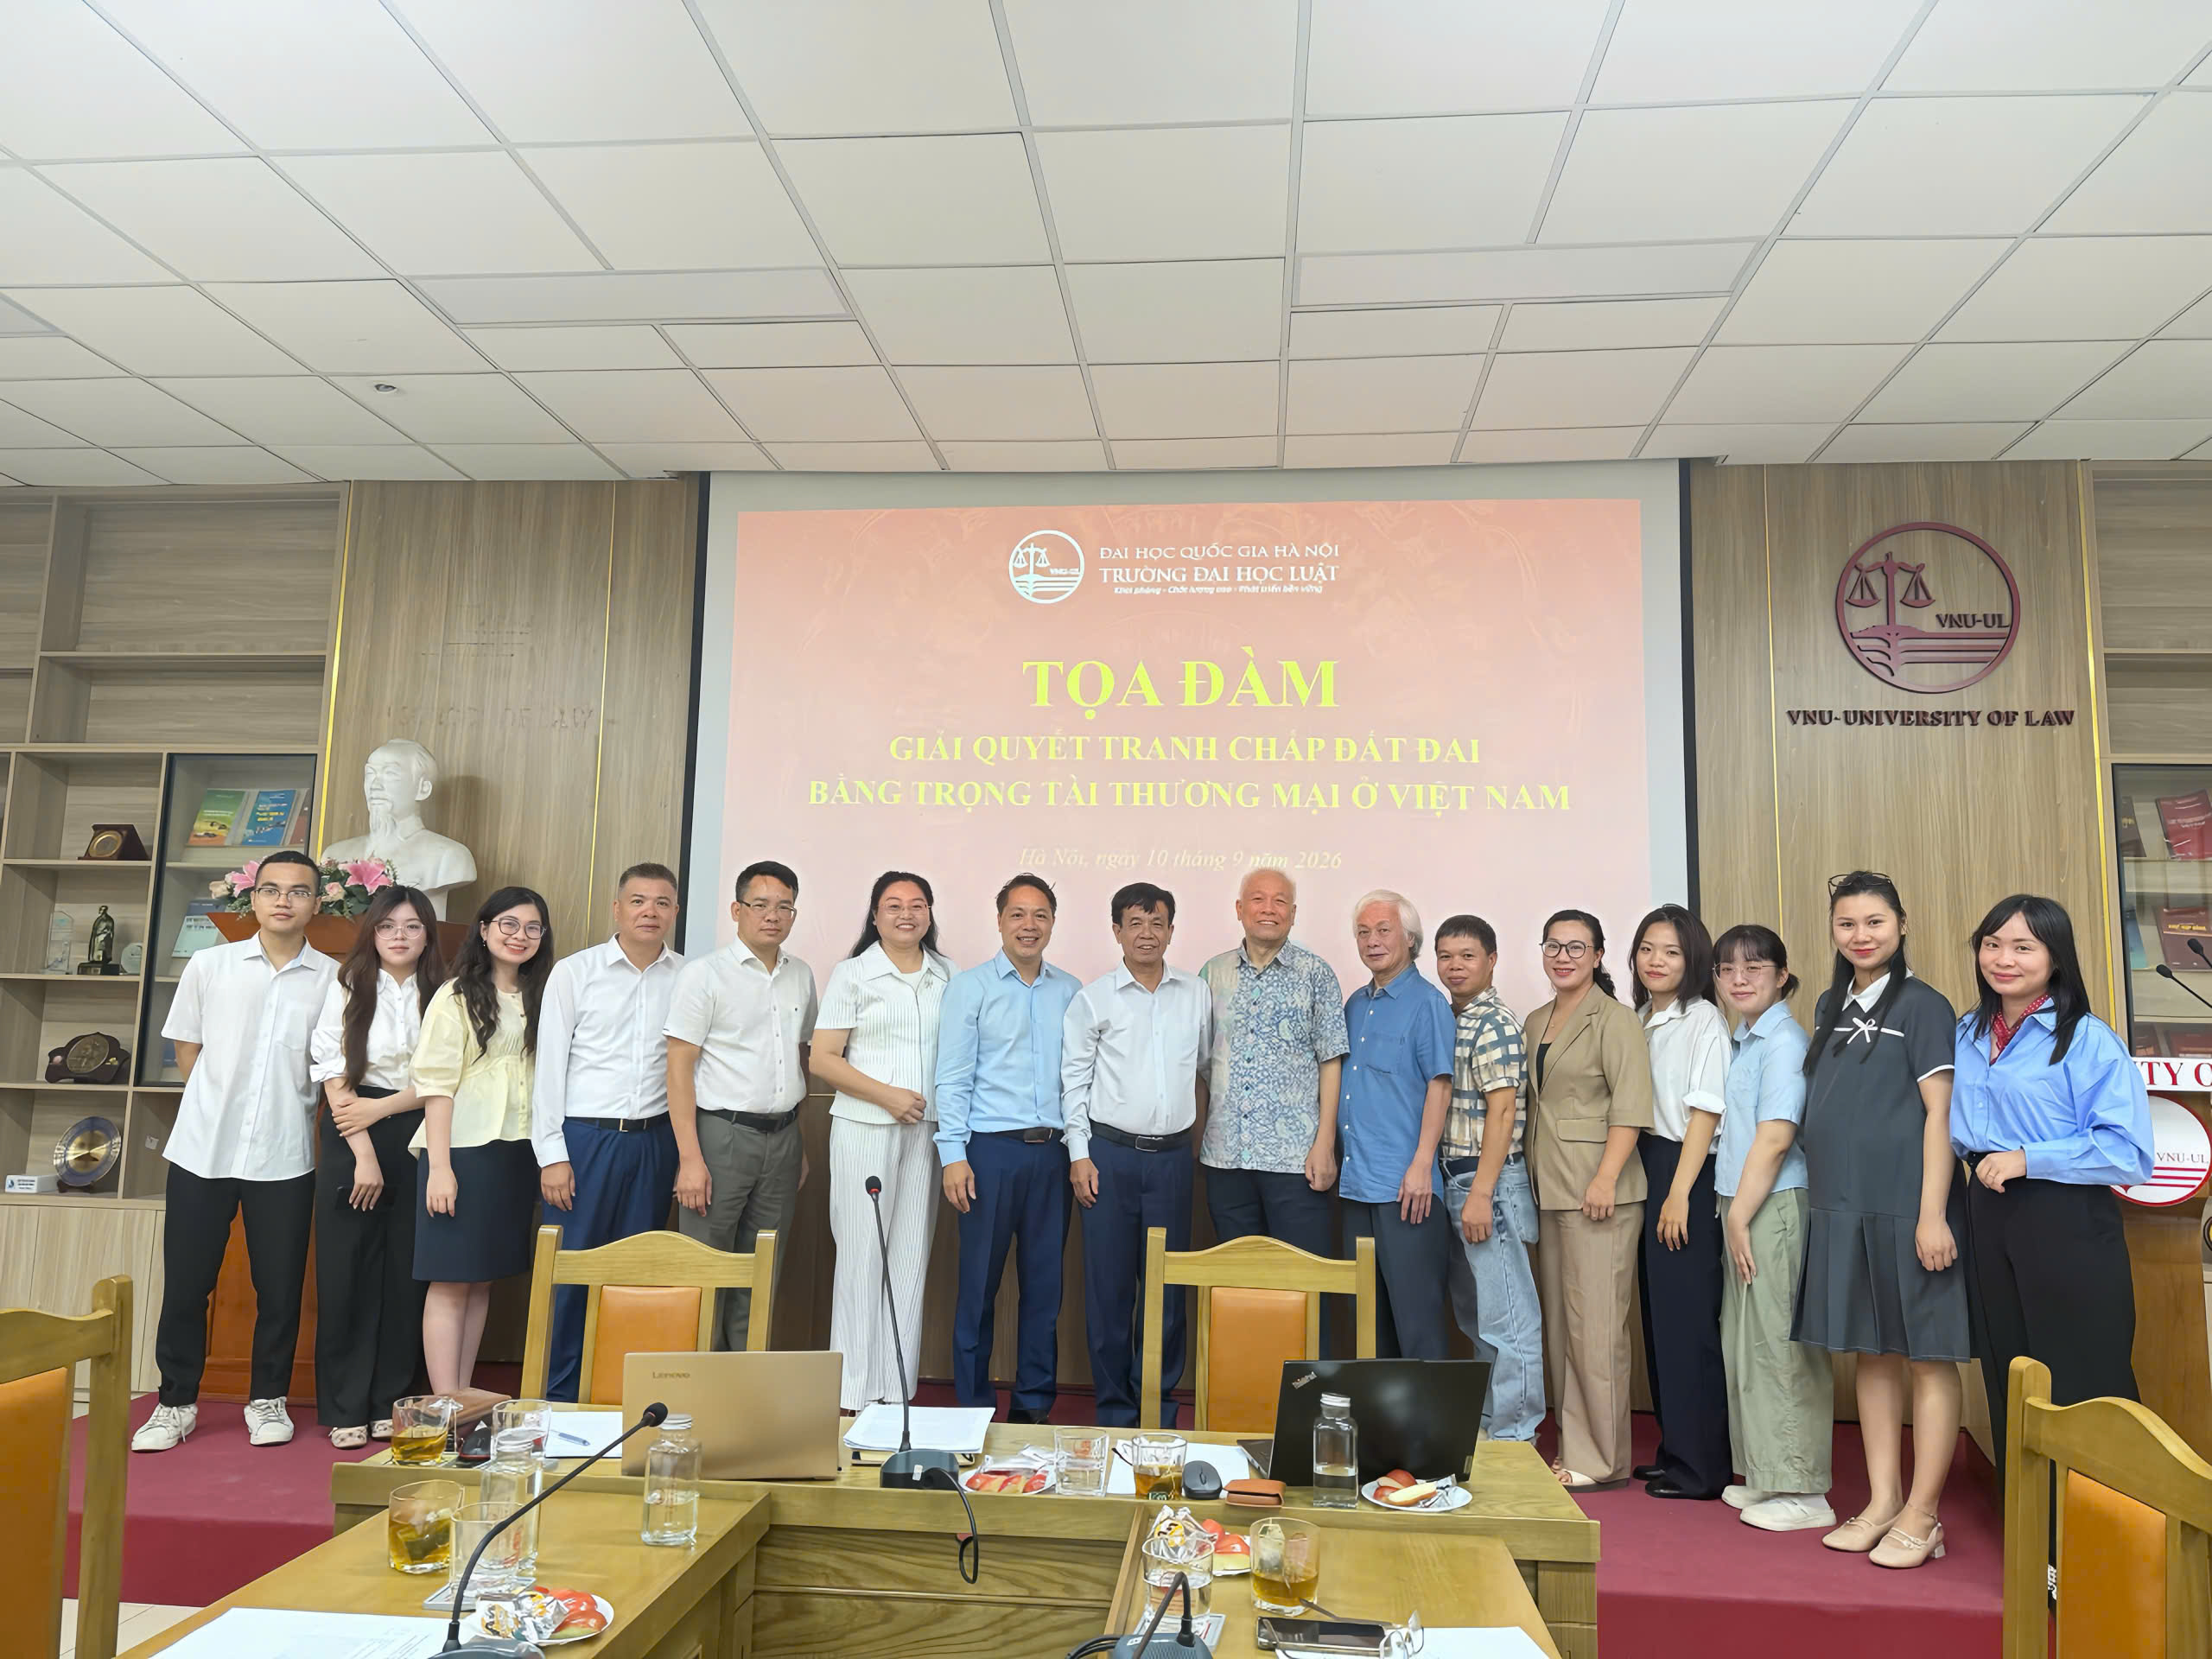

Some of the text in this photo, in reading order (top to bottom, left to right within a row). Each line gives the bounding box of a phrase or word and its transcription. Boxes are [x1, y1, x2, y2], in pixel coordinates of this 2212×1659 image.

[1135, 547, 1176, 561] HỌC
[1180, 542, 1233, 561] QUỐC
[1237, 546, 1269, 558] GIA
[1274, 543, 1300, 559] HÀ
[1305, 542, 1339, 560] NỘI
[1099, 564, 1187, 583] TRƯỜNG
[1236, 566, 1283, 584] HỌC
[1290, 562, 1341, 585] LUẬT
[1936, 613, 2010, 629] VNU-UL
[1022, 645, 1339, 720] TỌA ĐÀM
[1786, 709, 2075, 727] VNU-UNIVERSITY OF LAW
[889, 728, 963, 760] GIẢI
[973, 728, 1090, 766] QUYẾT
[1099, 735, 1218, 761] TRANH
[1415, 736, 1480, 763] ĐAI
[912, 780, 1032, 813] TRỌNG
[1040, 774, 1099, 807] TÀI
[1109, 778, 1261, 809] THƯƠNG
[1272, 781, 1340, 816] MẠI
[1351, 775, 1380, 810] Ở
[1388, 779, 1475, 818] VIỆT
[1485, 784, 1569, 810] NAM
[1019, 849, 1046, 865] Hà
[1147, 849, 1169, 865] 10
[1174, 849, 1226, 871] tháng
[1232, 849, 1245, 866] 9
[1249, 850, 1288, 867] năm
[1294, 849, 1342, 868] 2026
[2133, 1061, 2183, 1086] TY
[2156, 1152, 2209, 1165] VNU-UL
[652, 1370, 690, 1380] Lenovo
